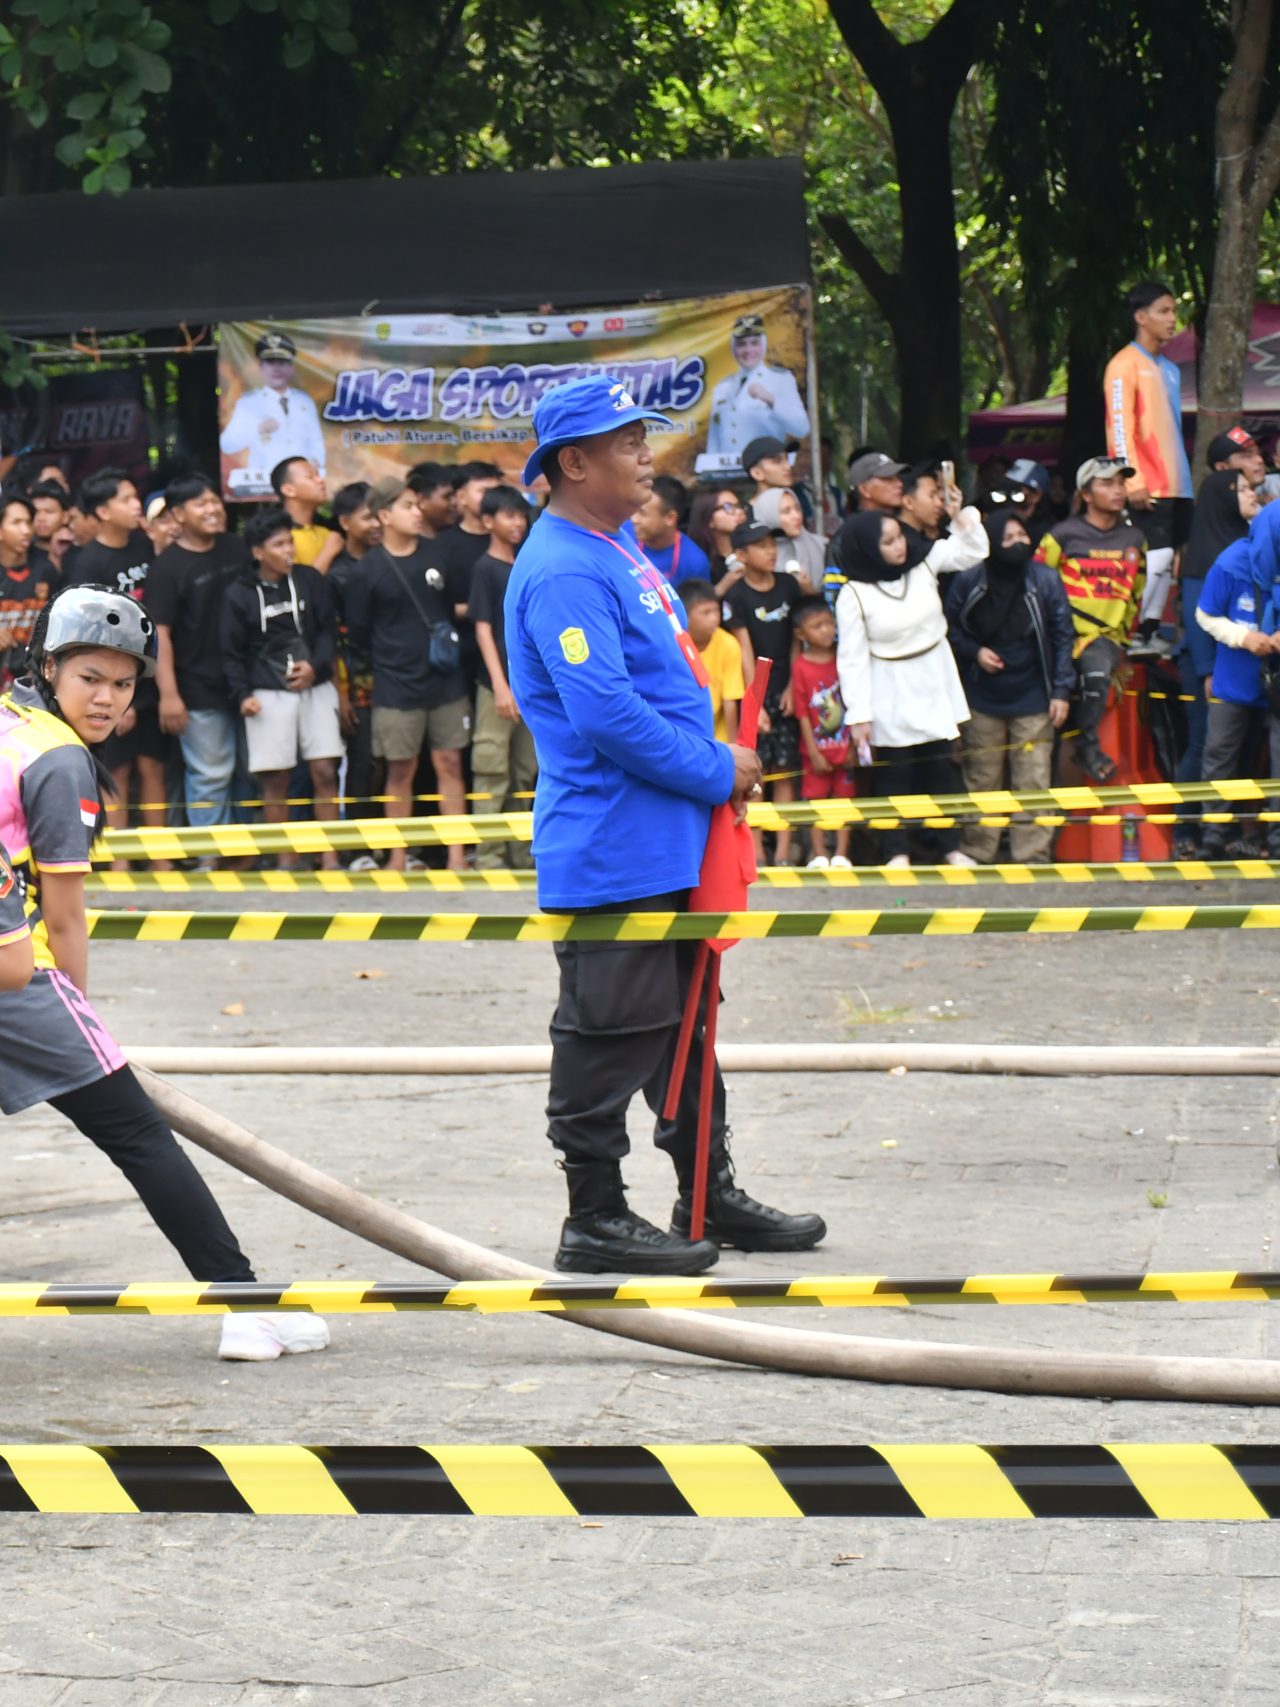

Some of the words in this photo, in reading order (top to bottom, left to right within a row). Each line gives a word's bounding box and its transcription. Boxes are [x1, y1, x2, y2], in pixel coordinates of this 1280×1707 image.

[324, 368, 435, 421] JAGA
[439, 356, 705, 420] SPORTAS
[56, 403, 136, 441] RAYA
